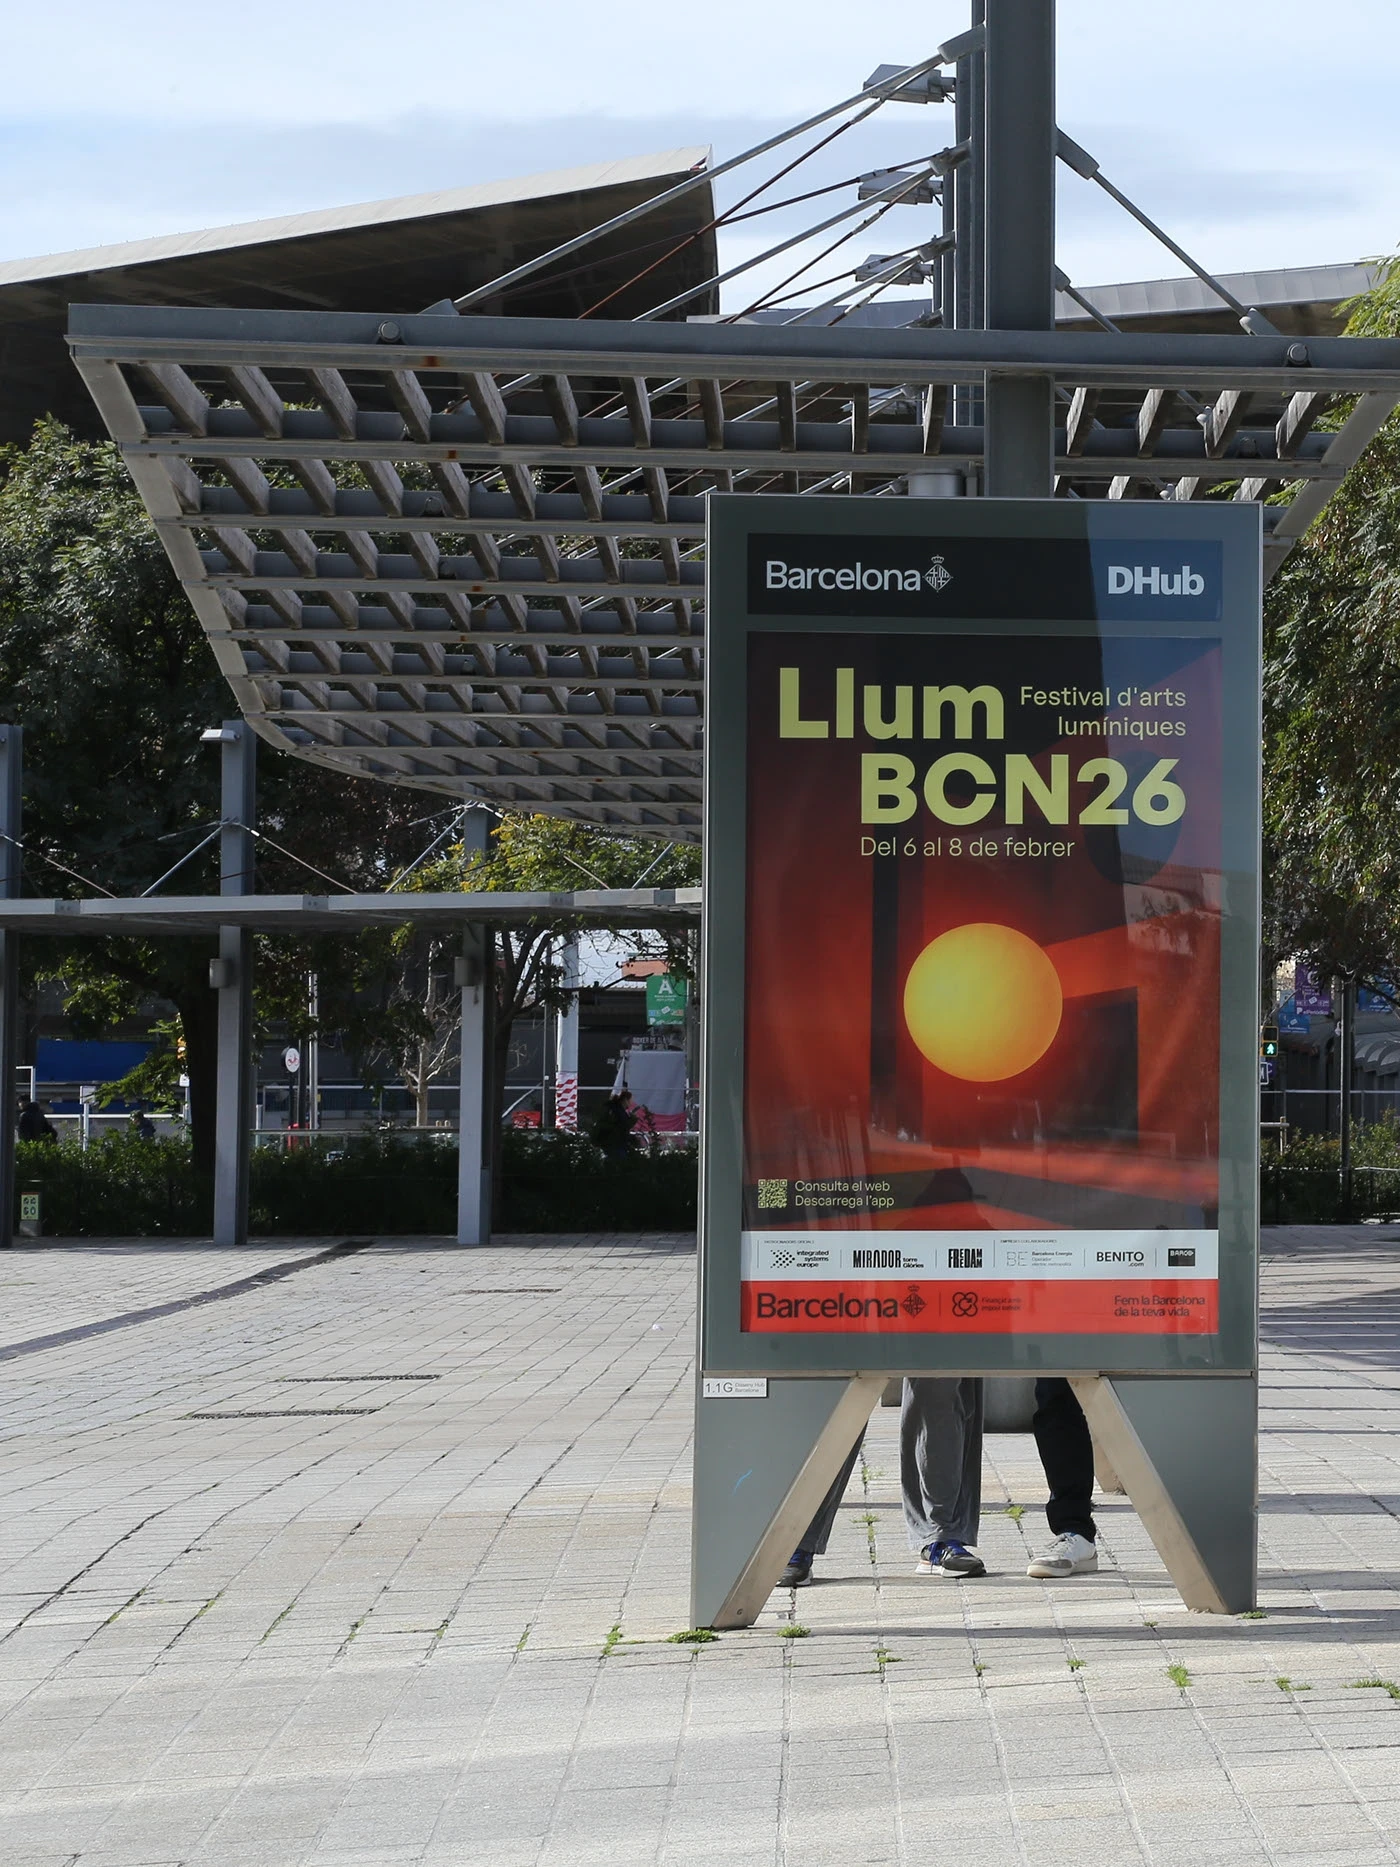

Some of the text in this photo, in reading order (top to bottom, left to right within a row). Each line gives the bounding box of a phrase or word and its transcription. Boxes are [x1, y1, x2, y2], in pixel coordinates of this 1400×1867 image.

[766, 560, 921, 592] Barcelona
[1107, 565, 1205, 596] DHub
[779, 667, 1004, 740] Llum
[1020, 685, 1186, 708] Festival d'arts
[1058, 715, 1186, 740] lumíniques
[861, 752, 1186, 826] BCN26
[860, 836, 1076, 857] Del 6 al 8 de febrer
[658, 979, 673, 995] A
[795, 1180, 890, 1192] Consulta el web
[795, 1195, 863, 1209] Descarrega
[796, 1250, 829, 1258] integrated
[853, 1249, 901, 1269] MIRADOR
[1096, 1251, 1145, 1262] BENITO
[757, 1292, 898, 1319] Barcelona
[1114, 1295, 1206, 1305] Fem la Barcelona
[1114, 1307, 1190, 1317] de la teva vida
